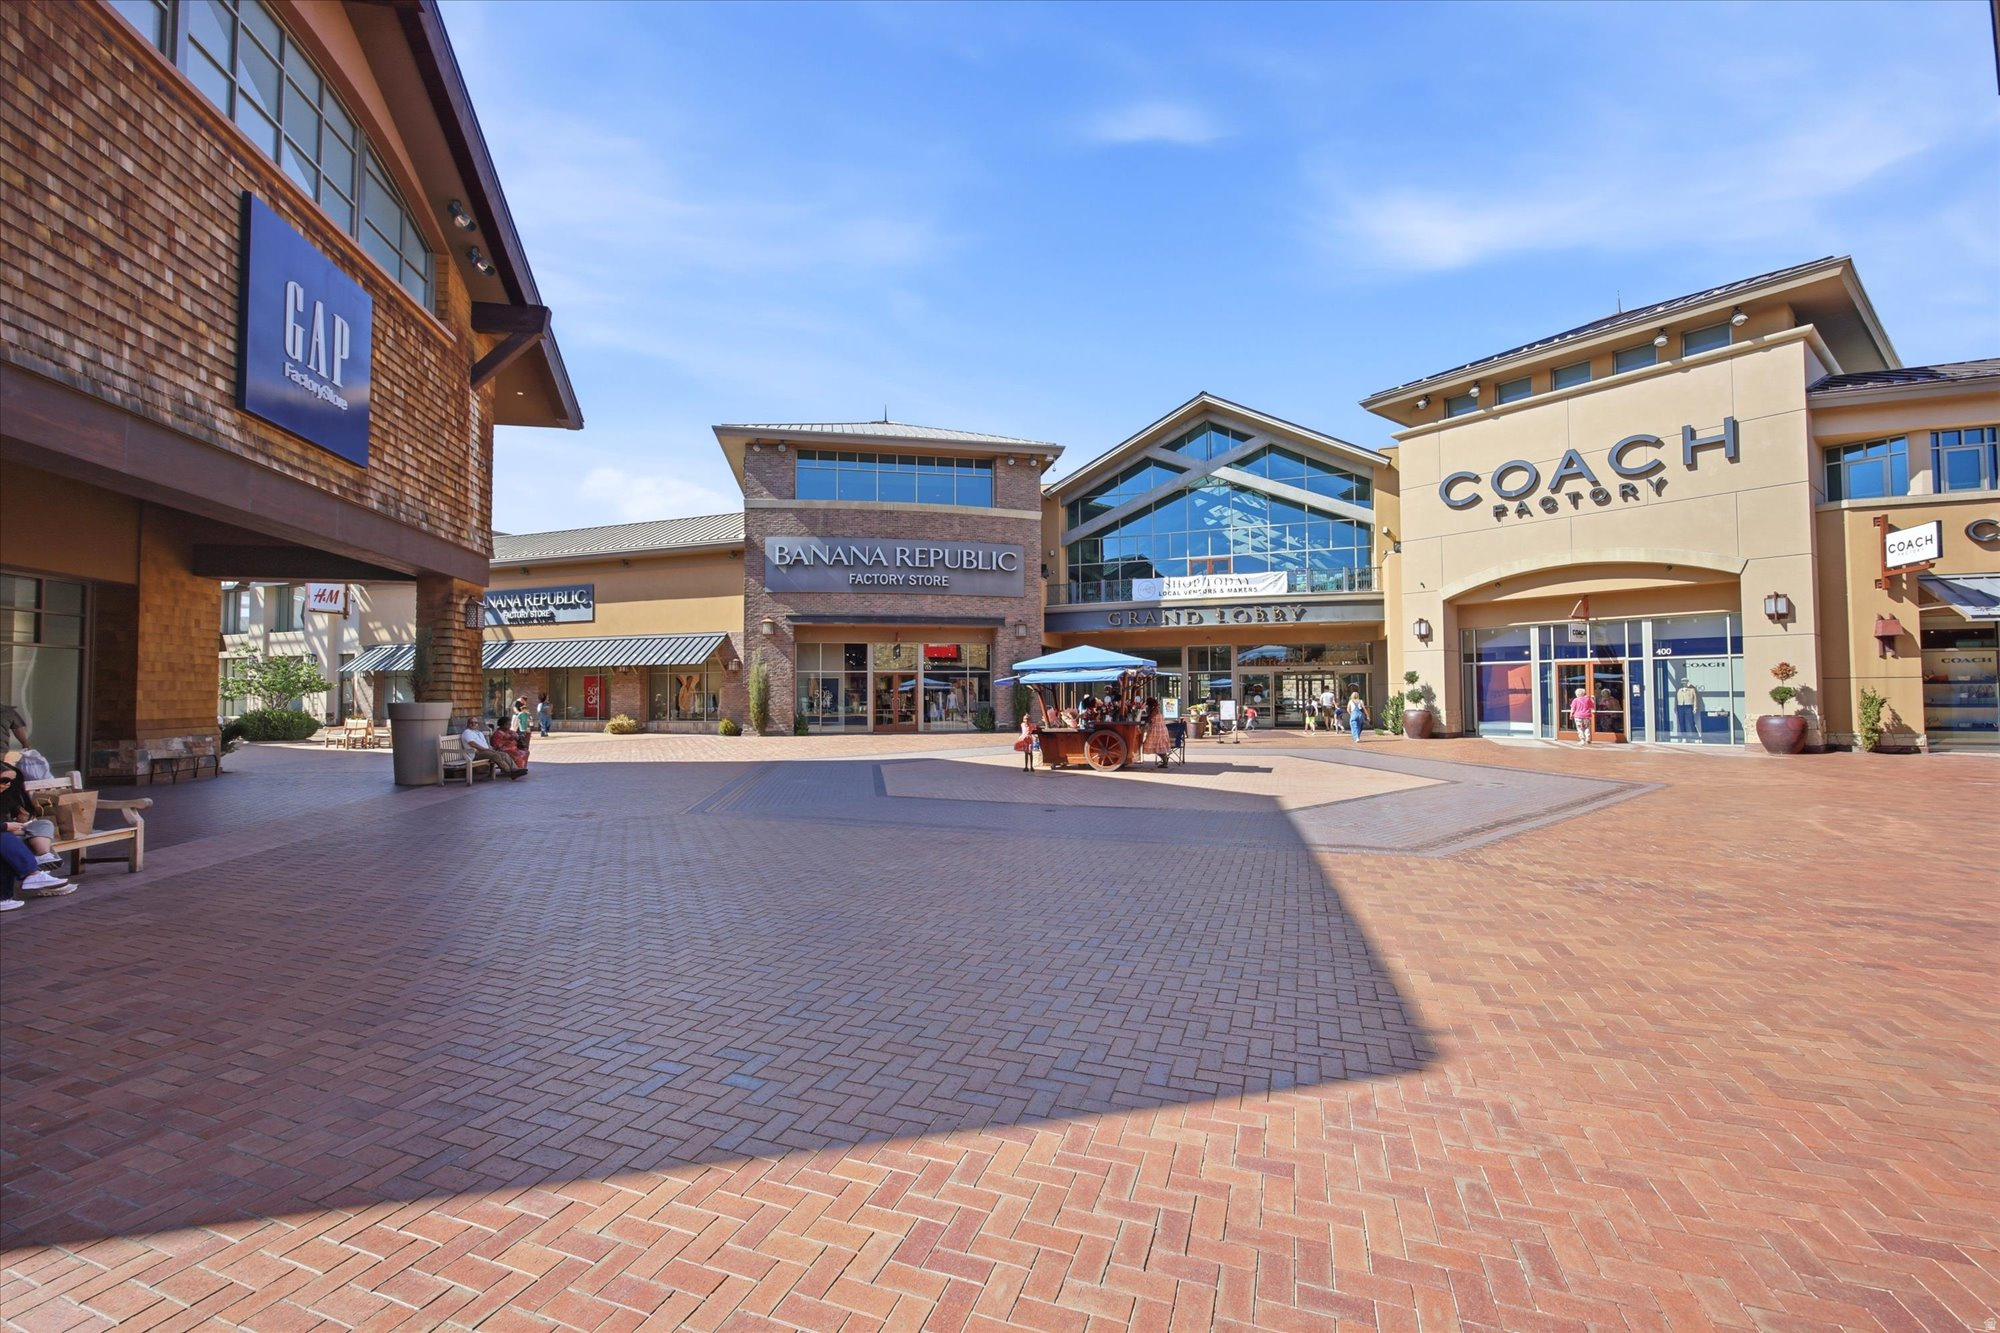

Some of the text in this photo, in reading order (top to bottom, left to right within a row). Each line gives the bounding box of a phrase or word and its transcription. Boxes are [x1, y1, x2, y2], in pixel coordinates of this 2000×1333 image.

[285, 281, 350, 388] GAP
[1438, 416, 1736, 507] COACH
[1493, 477, 1665, 517] FACTORY
[1888, 534, 1933, 553] COACH
[775, 544, 1017, 571] BANANA REPUBLIC
[849, 573, 949, 587] FACTORY STORE
[1165, 577, 1200, 589] SHOP
[484, 590, 587, 608] NANA REPUBLIC
[530, 609, 551, 618] STORE
[1108, 604, 1302, 625] GRAND LOBBY
